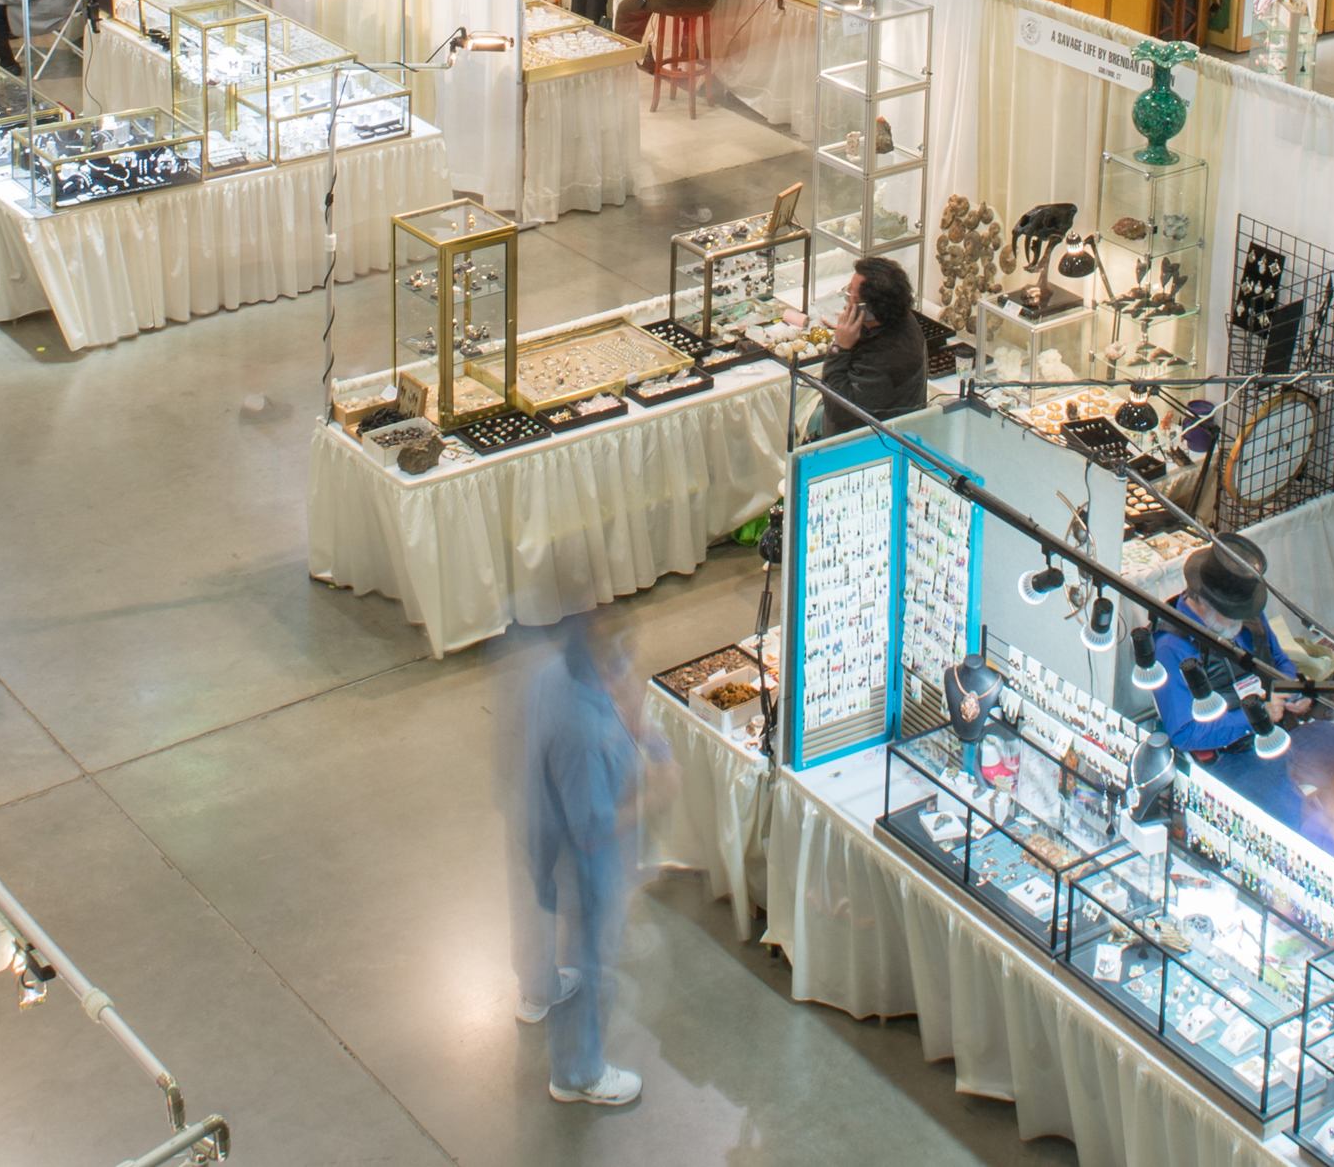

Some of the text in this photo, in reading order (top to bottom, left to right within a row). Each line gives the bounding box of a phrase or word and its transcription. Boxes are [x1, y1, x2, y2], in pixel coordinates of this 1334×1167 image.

[1050, 31, 1056, 42] A
[1057, 33, 1082, 53] SAVAGE
[1083, 42, 1096, 58] LIFE
[1097, 47, 1107, 61] BY
[1108, 50, 1139, 73] BRENDAN
